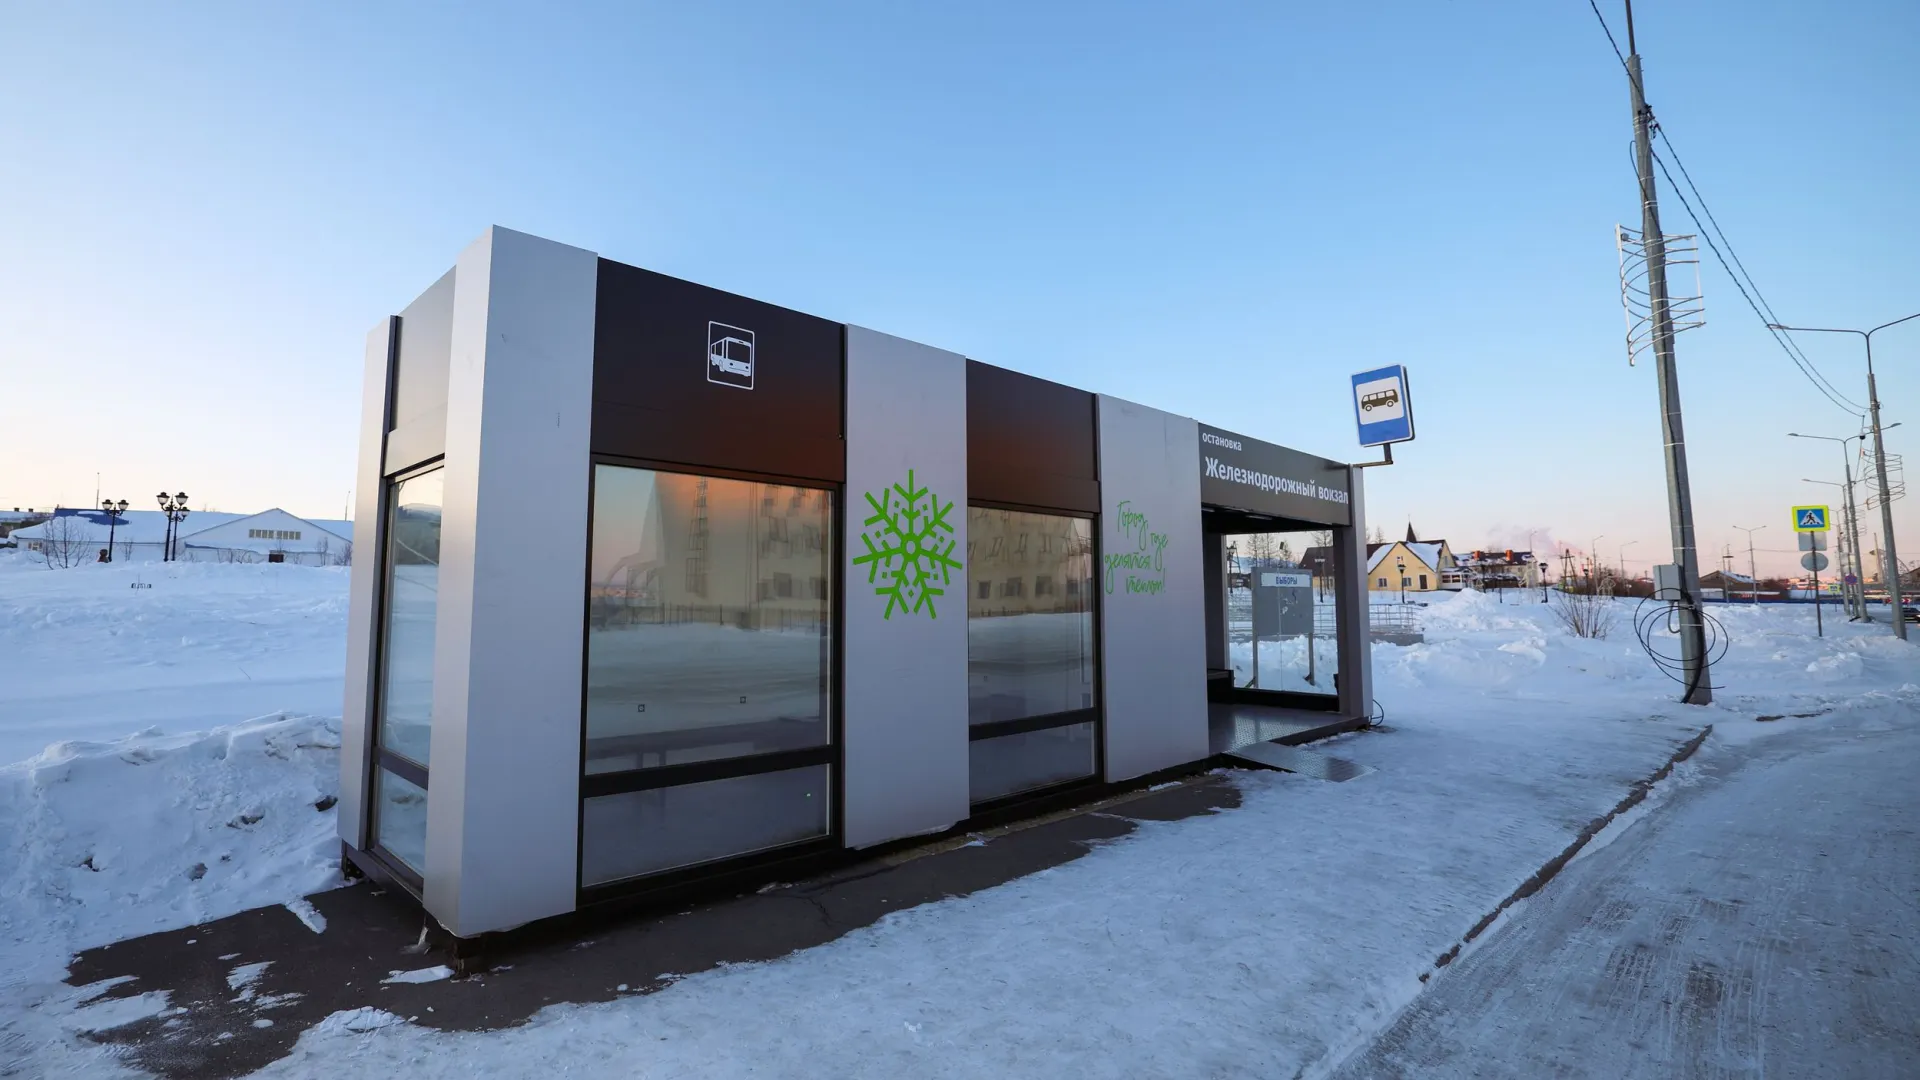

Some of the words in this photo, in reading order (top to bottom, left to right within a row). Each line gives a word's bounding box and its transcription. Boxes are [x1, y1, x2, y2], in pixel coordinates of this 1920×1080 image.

[1202, 432, 1242, 451] остановка
[1205, 456, 1316, 498] Железнодорожный
[1318, 486, 1349, 504] вокзал
[1275, 576, 1298, 585] ВЫБОРЫ
